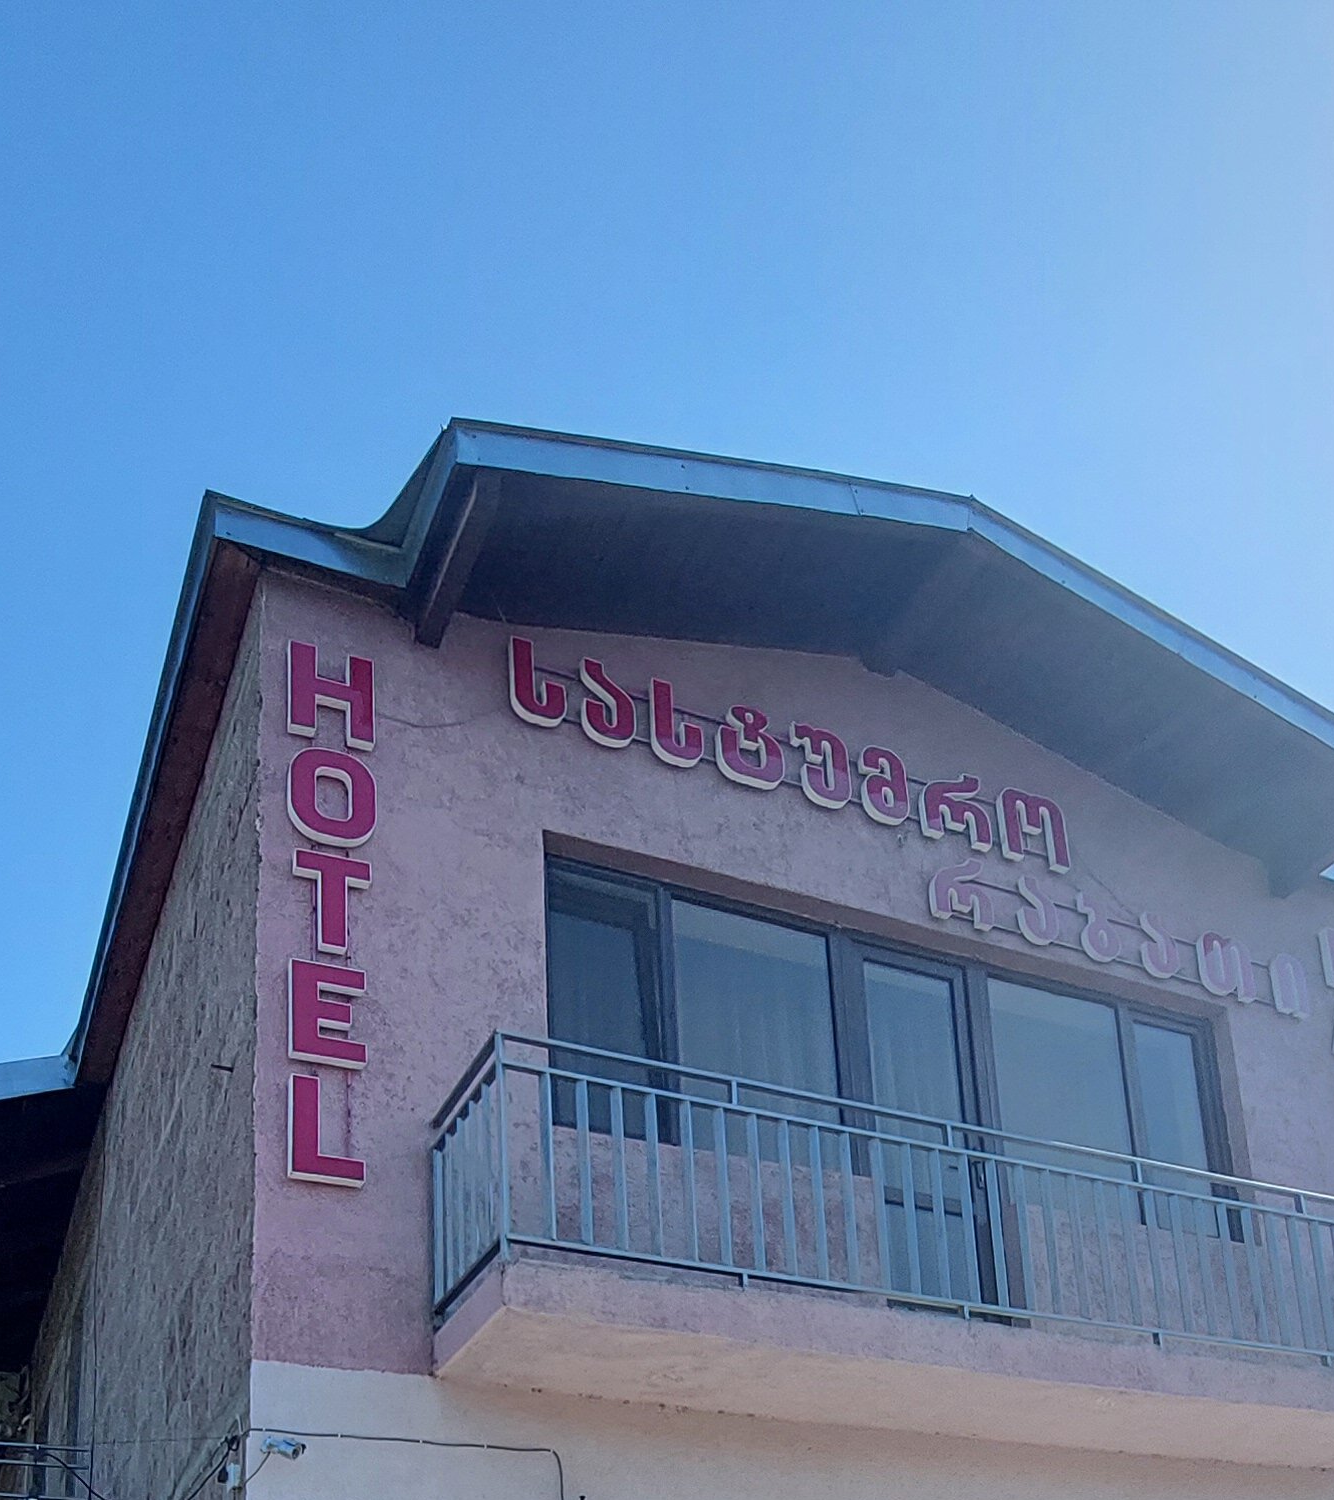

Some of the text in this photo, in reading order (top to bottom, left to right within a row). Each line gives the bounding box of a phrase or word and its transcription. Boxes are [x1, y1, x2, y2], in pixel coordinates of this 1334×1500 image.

[507, 635, 1071, 874] სასტუმრო
[286, 639, 378, 1189] HOTEL
[928, 858, 1310, 1019] რაბათი
